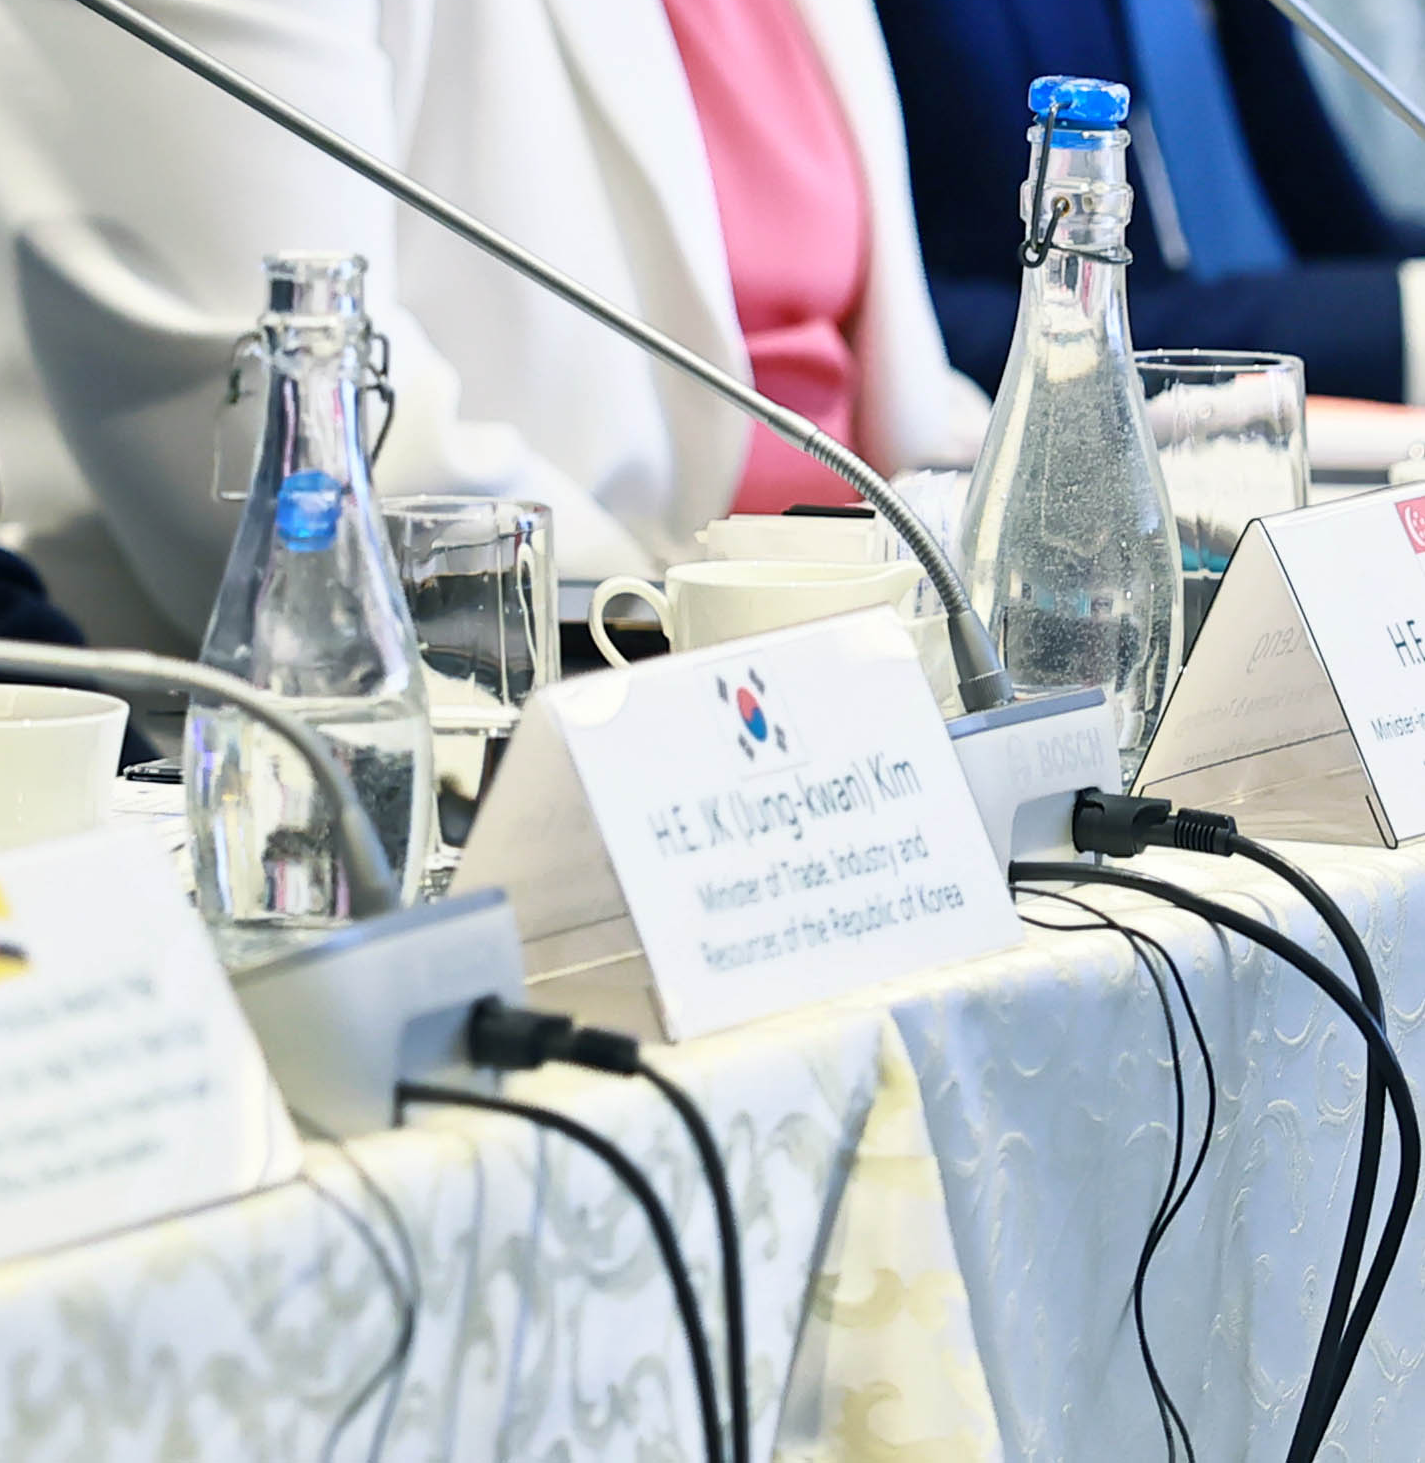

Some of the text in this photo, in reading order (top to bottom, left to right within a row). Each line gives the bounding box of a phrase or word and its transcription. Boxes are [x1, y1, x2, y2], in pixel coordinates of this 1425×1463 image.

[866, 751, 922, 801] Kim
[1037, 727, 1104, 777] BOSCH
[829, 844, 899, 880] Industry
[899, 825, 929, 864] and
[783, 916, 799, 953] of
[801, 916, 830, 948] the
[829, 893, 899, 942] Republic
[899, 884, 915, 921] of
[917, 883, 964, 914] Korea
